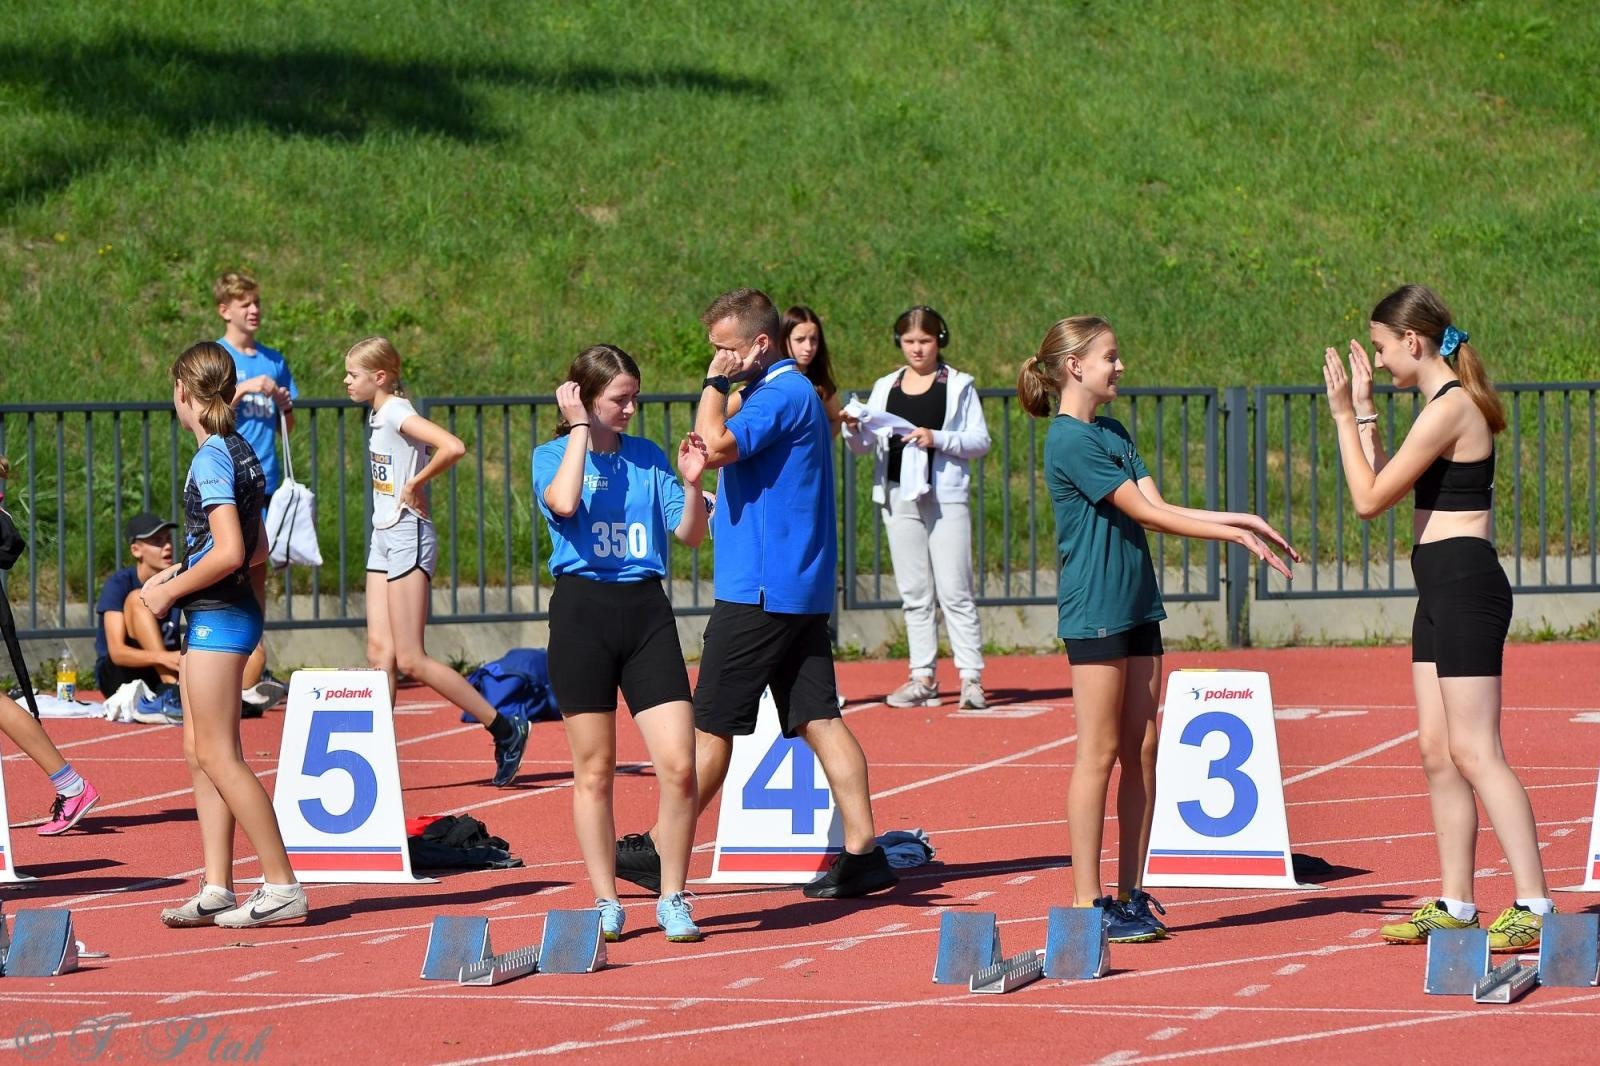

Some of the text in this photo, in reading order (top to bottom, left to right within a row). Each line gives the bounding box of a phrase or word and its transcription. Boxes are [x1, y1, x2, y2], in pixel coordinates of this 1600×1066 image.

[591, 521, 648, 559] 350
[325, 687, 373, 701] polanik
[1204, 687, 1253, 702] polanik
[298, 711, 378, 834] 5
[742, 731, 830, 835] 4
[1177, 711, 1259, 838] 3
